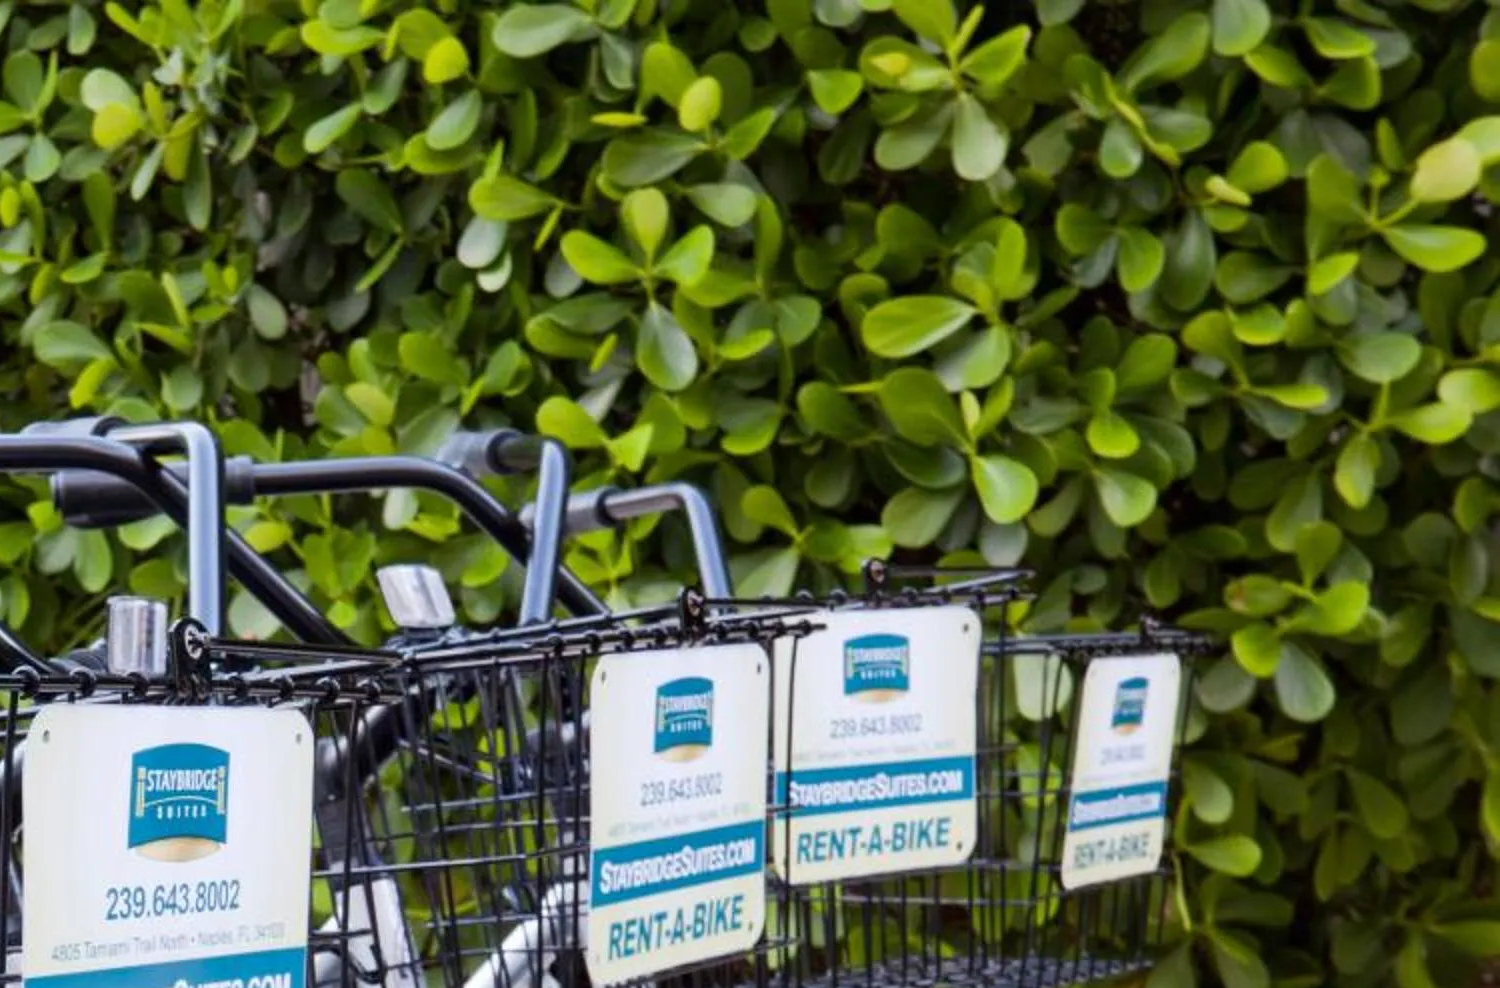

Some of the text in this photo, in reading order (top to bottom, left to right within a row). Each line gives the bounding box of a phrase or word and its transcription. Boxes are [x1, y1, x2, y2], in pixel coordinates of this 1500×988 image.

[146, 768, 217, 792] STAYBRIDGE
[796, 817, 952, 865] RENT-A-BIKE
[104, 879, 241, 921] 239.643.8002
[607, 894, 745, 961] RENT-A-BIKE
